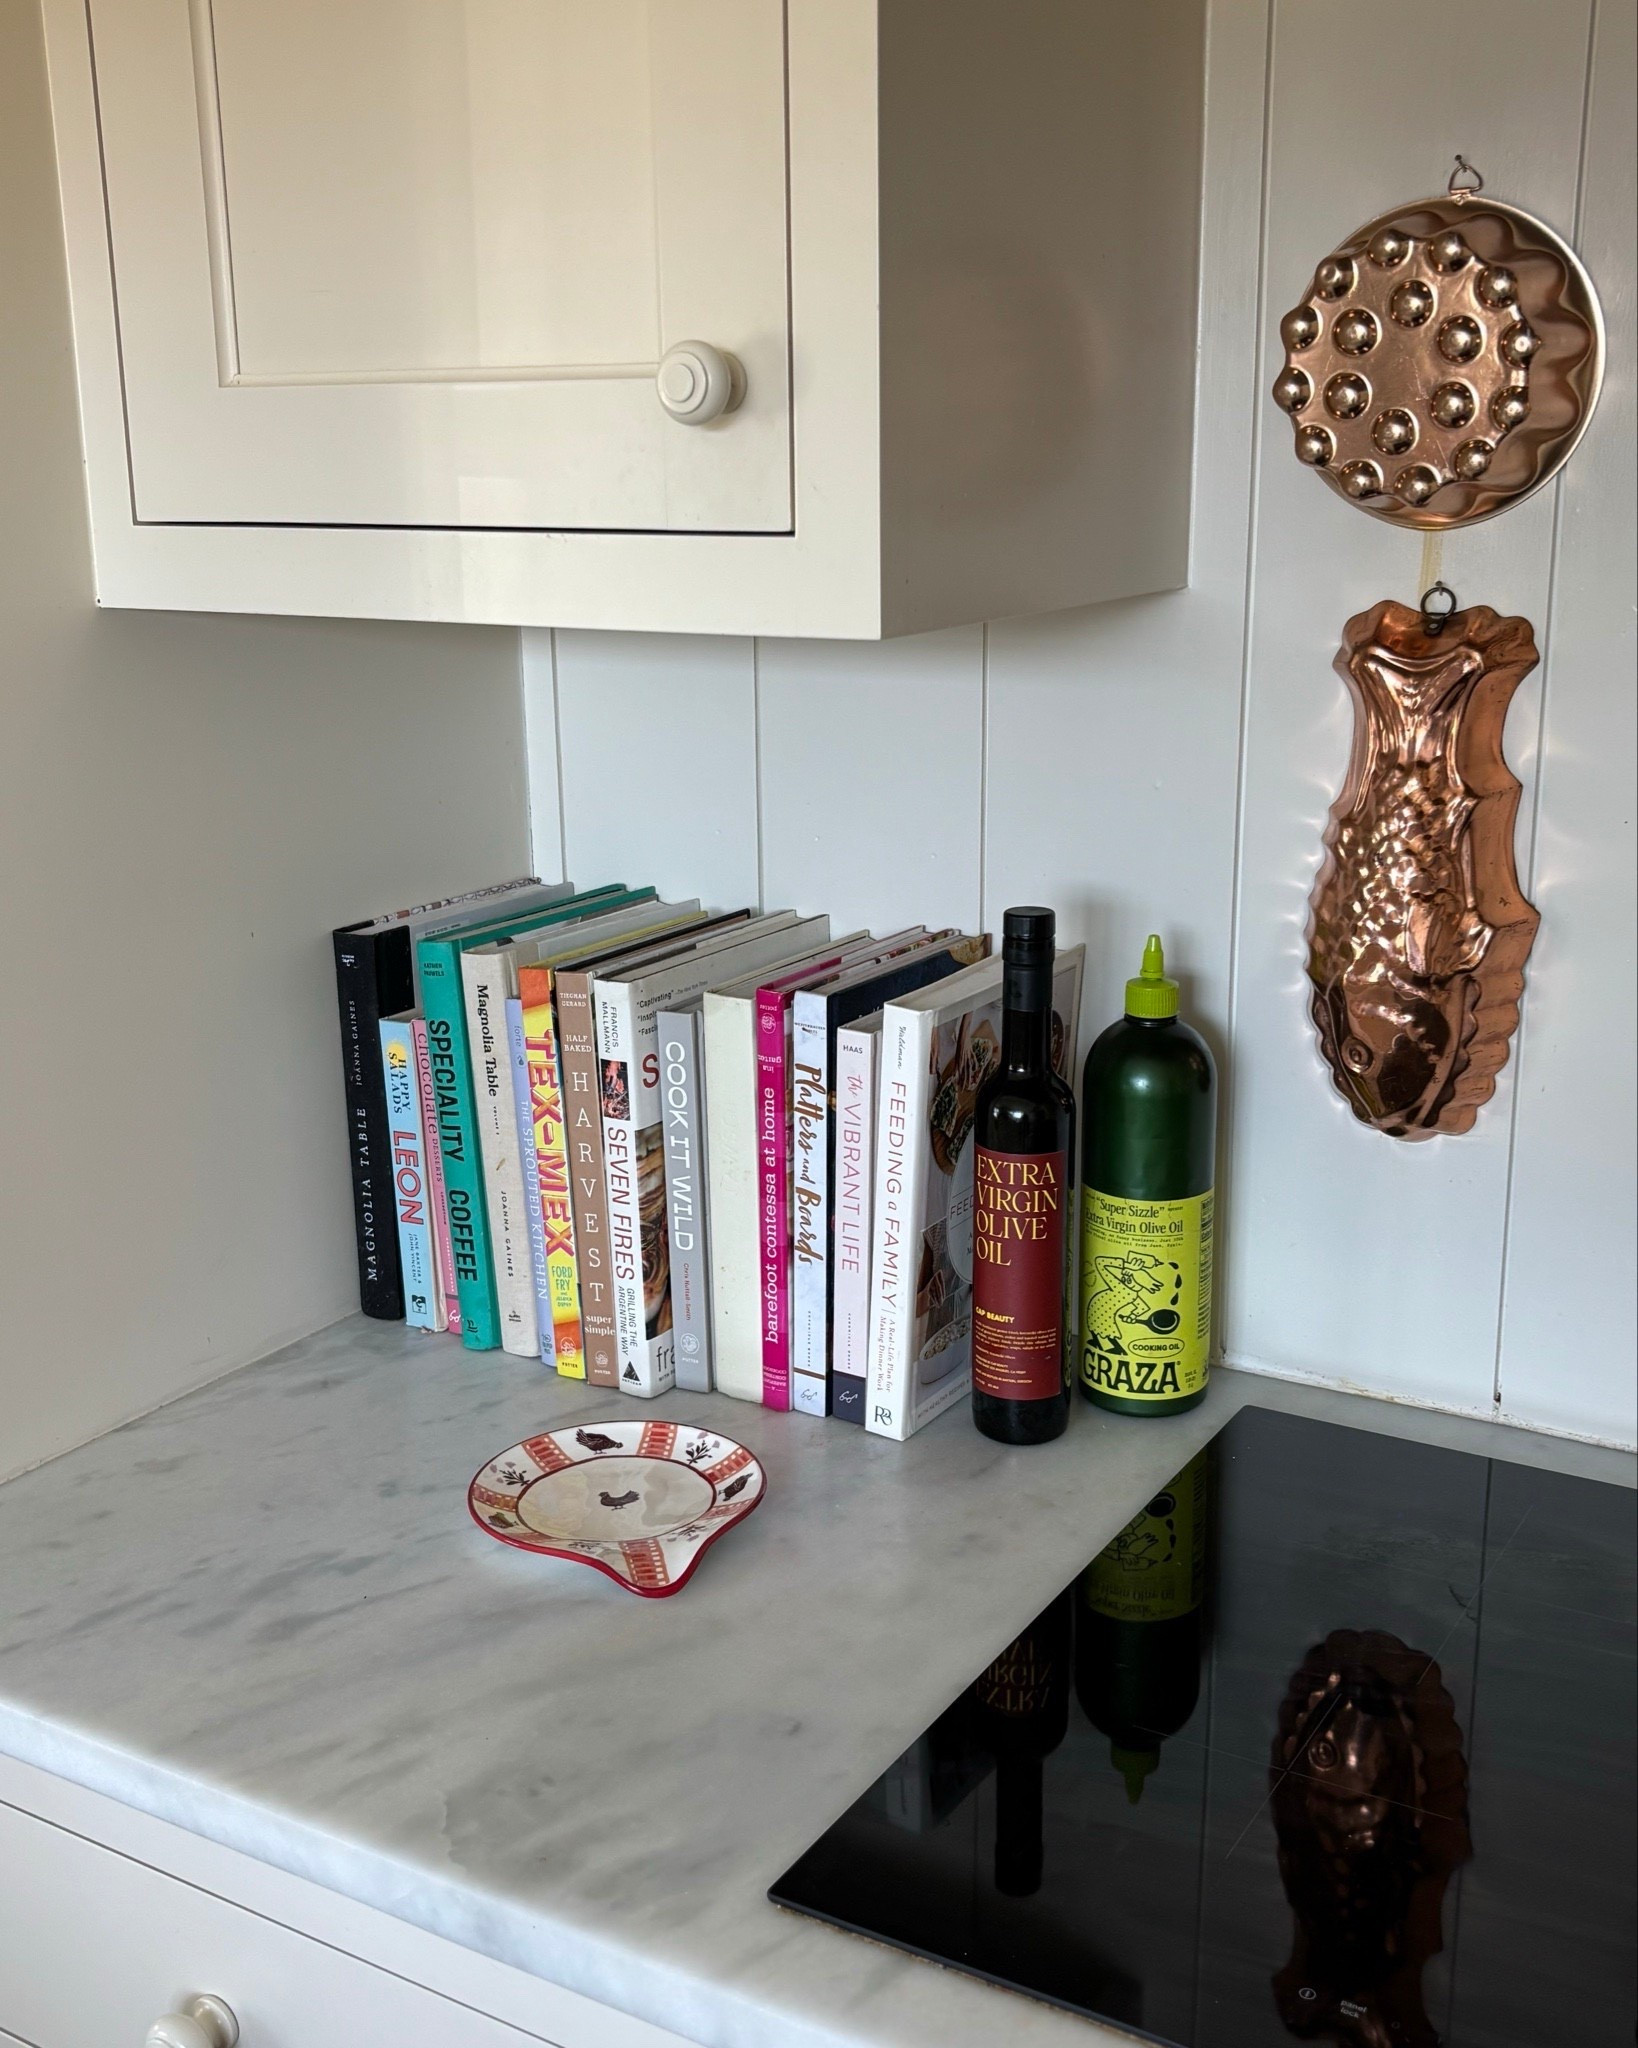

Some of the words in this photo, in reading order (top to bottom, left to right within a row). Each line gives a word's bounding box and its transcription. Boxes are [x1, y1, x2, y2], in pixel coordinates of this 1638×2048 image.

[349, 1000, 358, 1039] GAINES
[477, 984, 495, 1053] Magnolia
[566, 1034, 588, 1043] HALF
[602, 1001, 610, 1054] MALLMANN
[610, 1006, 619, 1048] FRANCIS
[352, 1044, 363, 1086] JOANNA
[564, 1044, 592, 1053] BAKED
[843, 1044, 863, 1054] HAAS
[388, 1052, 402, 1114] SALADS
[398, 1059, 411, 1111] HAPPY
[485, 1057, 499, 1097] Table
[665, 1041, 689, 1129] COOK
[847, 1074, 863, 1097] the
[418, 1033, 437, 1134] chocolate
[432, 1138, 442, 1182] DESSERTS
[520, 1101, 530, 1122] THE
[762, 1088, 775, 1142] home
[794, 1063, 826, 1155] Platters
[357, 1108, 370, 1166] TABLE
[429, 1020, 464, 1162] SPECIALITY
[449, 1189, 478, 1282] COFFEE
[525, 1029, 574, 1257] TEX-MEX
[670, 1135, 691, 1169] IT
[763, 1147, 775, 1167] at
[886, 1081, 906, 1195] FEEDING
[393, 1130, 424, 1225] LEON
[522, 1129, 540, 1216] SPROUTED
[607, 1126, 630, 1205] SEVEN
[800, 1157, 816, 1185] and
[843, 1103, 861, 1215] VIBRANT
[977, 1154, 1056, 1186] EXTRA
[572, 1072, 604, 1302] HARVEST
[888, 1201, 898, 1211] a
[977, 1181, 1058, 1213] VIRGIN
[1097, 1196, 1126, 1216] “Super
[1129, 1204, 1165, 1219] Sizzle”
[361, 1179, 377, 1281] MAGNOLIA
[672, 1175, 693, 1251] WILD
[765, 1174, 777, 1259] contessa
[794, 1186, 824, 1270] Boards
[976, 1209, 1048, 1240] OLIVE
[1086, 1207, 1105, 1226] Extra
[1106, 1216, 1136, 1234] Virgin
[1140, 1221, 1166, 1233] Olive
[1169, 1220, 1183, 1233] Oil
[501, 1191, 509, 1232] JOANNA
[505, 1238, 514, 1278] GAINES
[613, 1213, 635, 1281] FIRES
[842, 1223, 860, 1273] LIFE
[976, 1236, 1012, 1266] OIL
[532, 1223, 547, 1300] KITCHEN
[551, 1265, 573, 1278] FORD
[882, 1217, 900, 1308] FAMILY
[555, 1279, 570, 1291] FRY
[765, 1264, 778, 1344] barefoot
[586, 1315, 612, 1325] super
[618, 1285, 628, 1334] ARGENTINE
[626, 1288, 637, 1328] GRILLING
[975, 1306, 986, 1316] CAP
[986, 1312, 1015, 1324] BEAUTY
[585, 1325, 615, 1336] simple
[629, 1330, 638, 1347] THE
[878, 1316, 887, 1343] Making
[1132, 1344, 1168, 1352] COOKING
[1083, 1347, 1181, 1394] GRAZA
[1340, 2007, 1359, 2018] lock
[1341, 2000, 1368, 2013] panel
